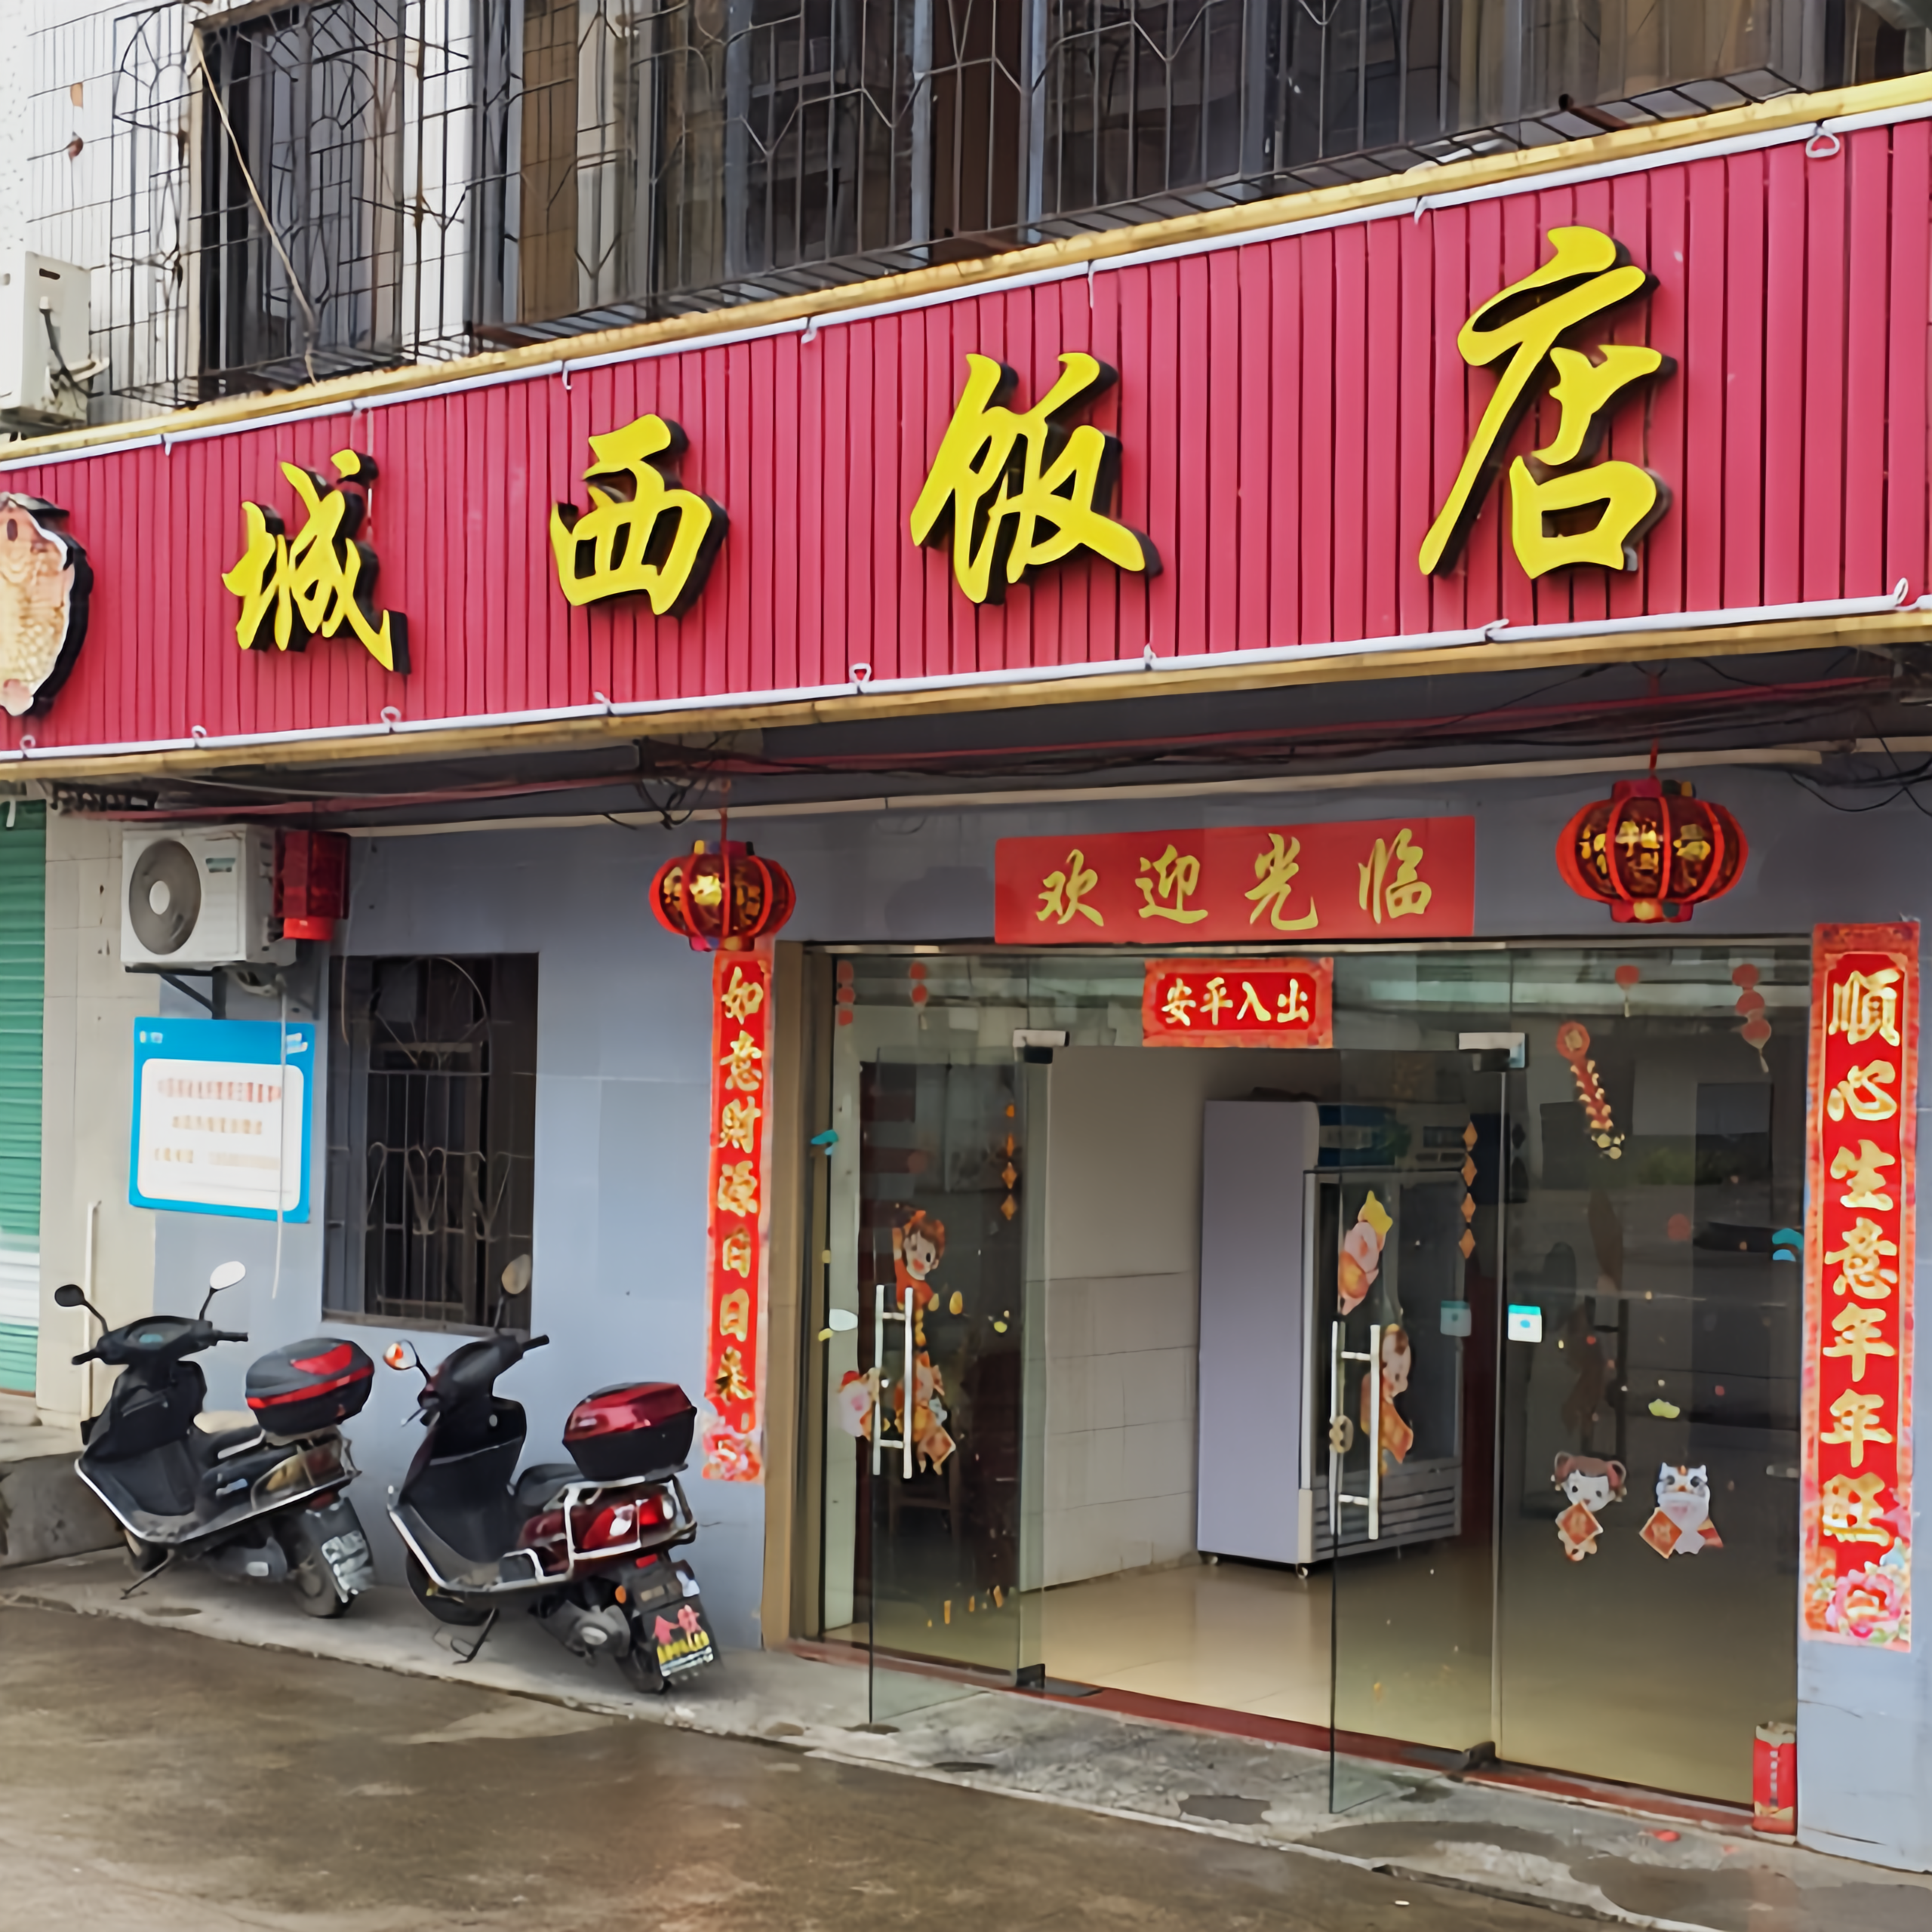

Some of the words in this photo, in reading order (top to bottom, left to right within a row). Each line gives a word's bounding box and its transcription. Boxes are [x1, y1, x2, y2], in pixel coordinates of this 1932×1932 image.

[222, 226, 1663, 670] 城西饭店
[1036, 828, 1432, 931] 欢迎光临
